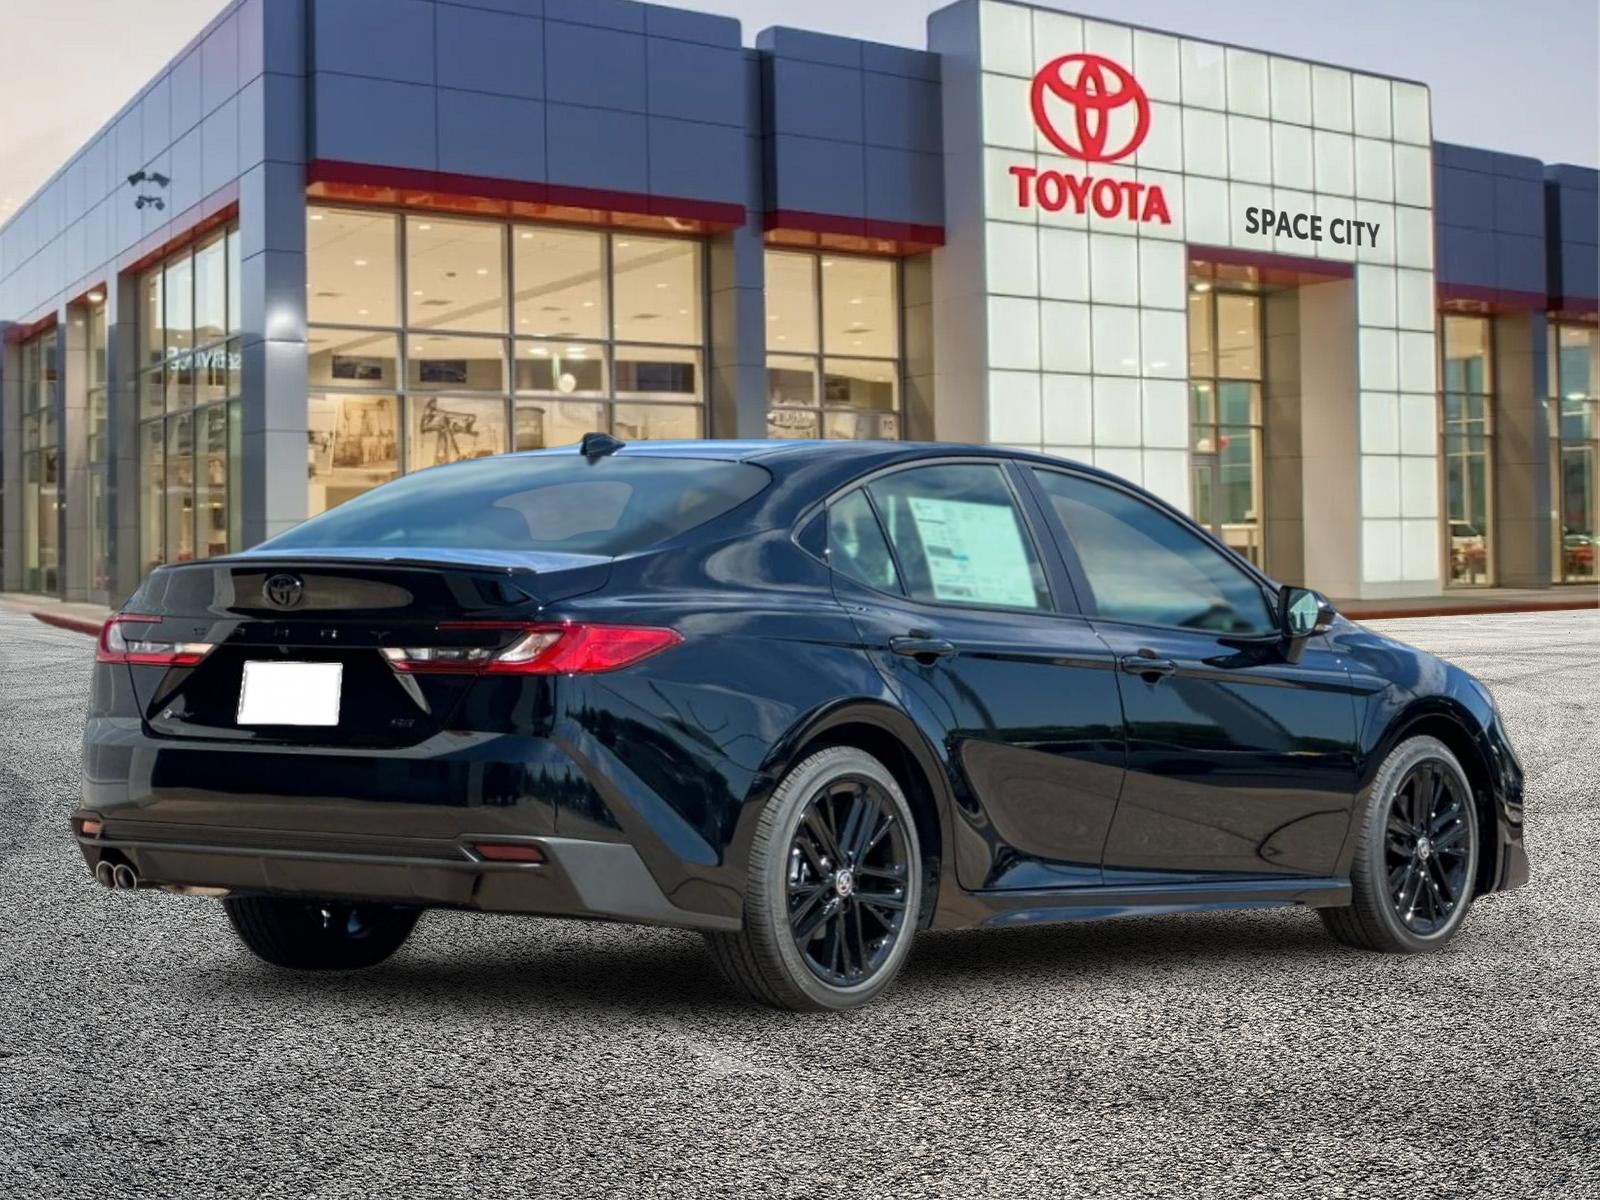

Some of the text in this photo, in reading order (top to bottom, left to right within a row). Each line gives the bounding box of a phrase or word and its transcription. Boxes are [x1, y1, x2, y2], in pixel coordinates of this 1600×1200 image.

[1009, 166, 1171, 225] TOYOTA
[1245, 207, 1380, 248] SPACE CITY
